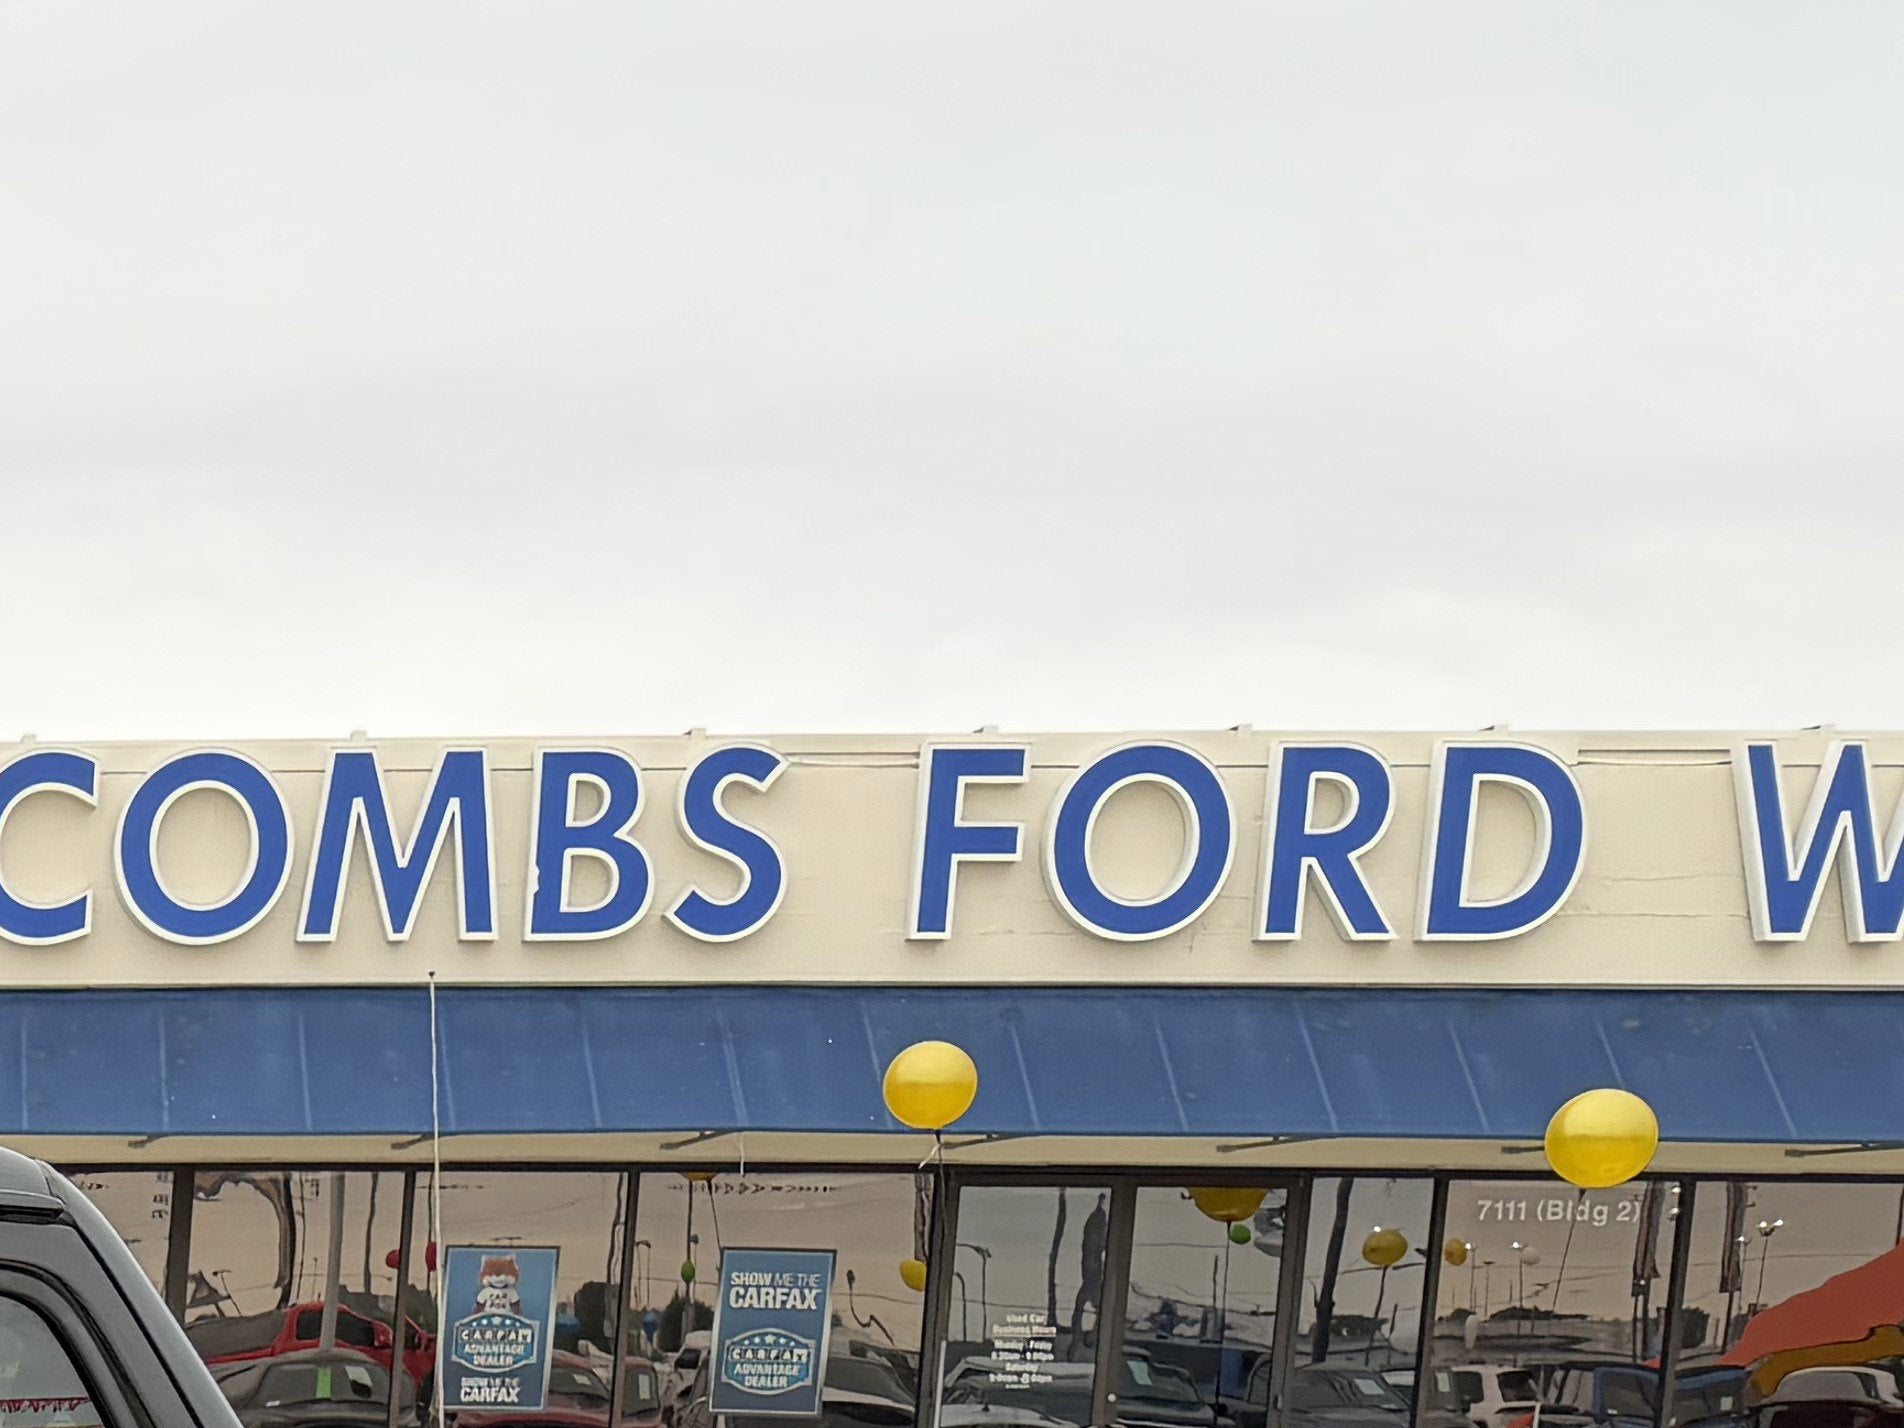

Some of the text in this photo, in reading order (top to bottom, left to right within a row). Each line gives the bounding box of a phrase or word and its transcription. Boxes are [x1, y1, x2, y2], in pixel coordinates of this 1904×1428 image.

[903, 738, 1588, 944] FORD
[1477, 1199, 1642, 1227] 7111 (Bldg 2)
[730, 1271, 822, 1288] SHOW ME THE
[729, 1286, 823, 1310] CARFAX
[473, 1354, 514, 1366] DEALER
[734, 1363, 800, 1375] ADVANTAGE
[744, 1375, 788, 1387] DEALER
[460, 1386, 523, 1403] CARFAX
